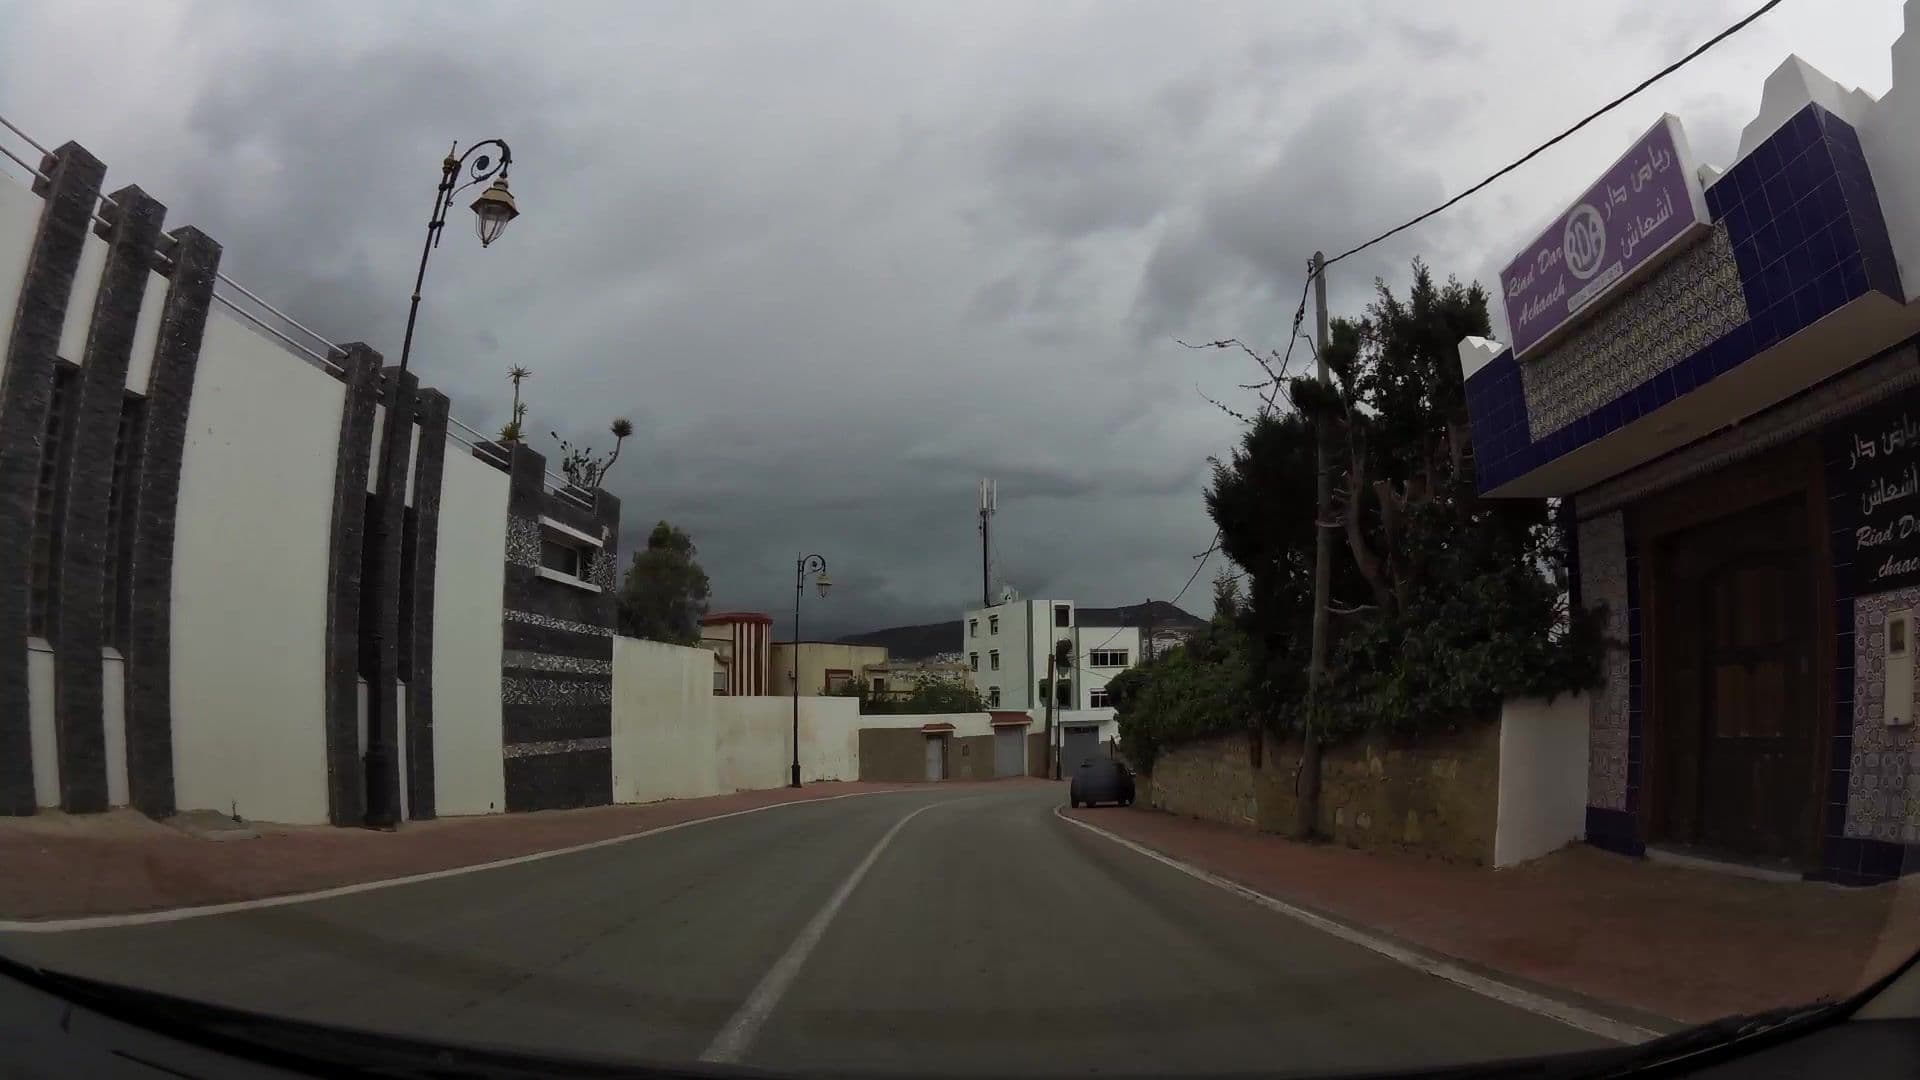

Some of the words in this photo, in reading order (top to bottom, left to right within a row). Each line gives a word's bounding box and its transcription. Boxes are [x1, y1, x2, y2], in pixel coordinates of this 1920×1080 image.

[1631, 145, 1671, 192] رياض
[1603, 183, 1627, 221] دار
[1508, 264, 1536, 303] Riad
[1537, 247, 1563, 275] Dar
[1848, 433, 1875, 470] دار
[1856, 520, 1894, 551] Riad
